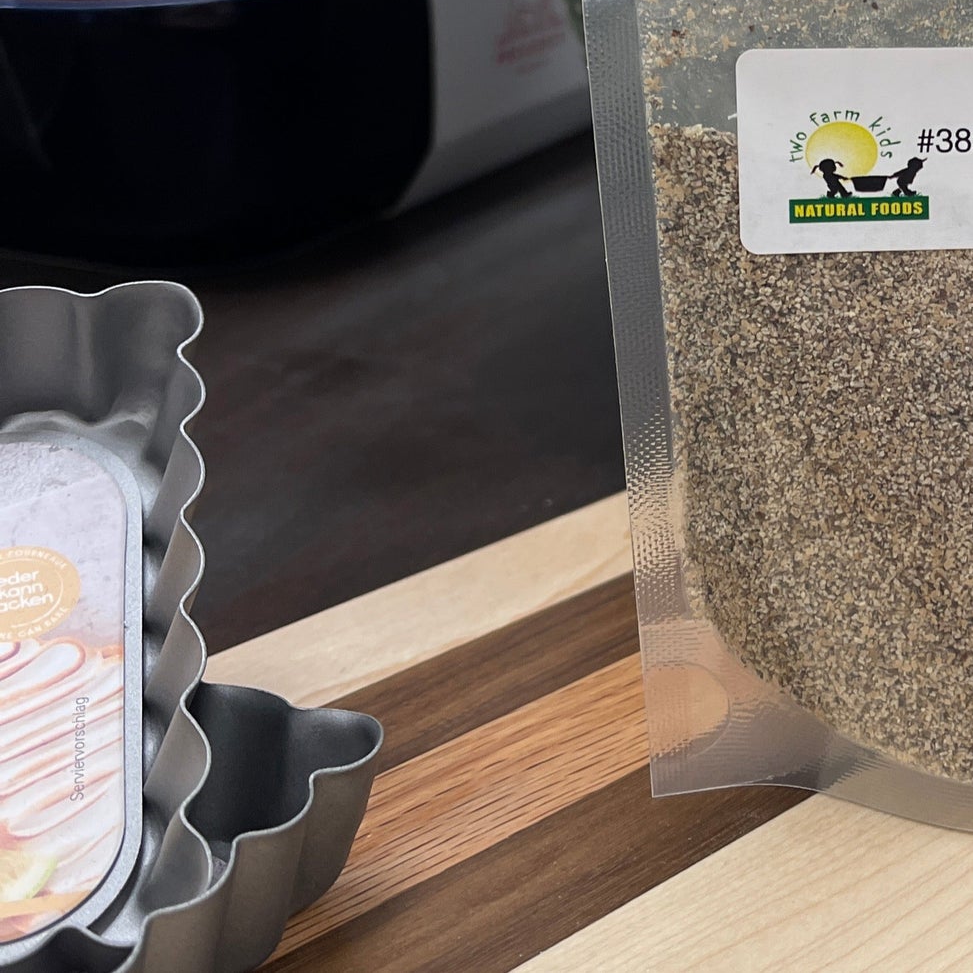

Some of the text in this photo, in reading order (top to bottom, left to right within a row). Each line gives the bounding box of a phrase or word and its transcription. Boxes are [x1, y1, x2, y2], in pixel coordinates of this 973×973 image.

[789, 109, 902, 163] two farm kids
[794, 201, 924, 218] NATURAL FOODS
[0, 570, 39, 587] eder
[0, 592, 54, 612] acken
[70, 696, 90, 801] Serviervorschlag
